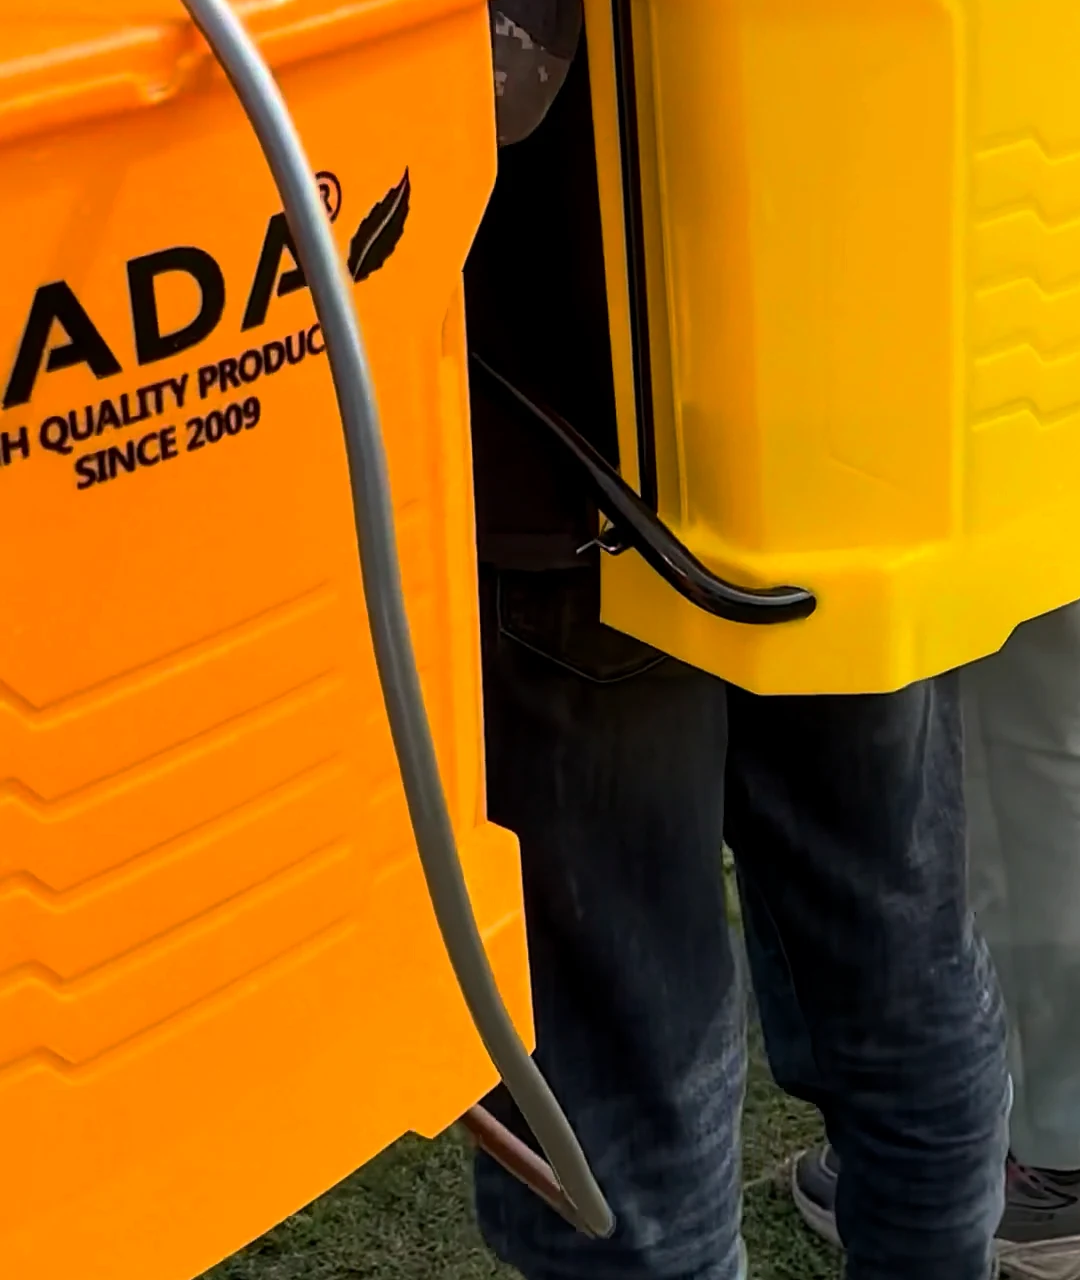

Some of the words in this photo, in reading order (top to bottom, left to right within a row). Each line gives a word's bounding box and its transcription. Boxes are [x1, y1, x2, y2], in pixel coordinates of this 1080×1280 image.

[39, 374, 190, 455] QUALITY
[200, 324, 326, 399] PRODUC
[75, 426, 179, 490] SINCE
[187, 396, 261, 451] 2009
